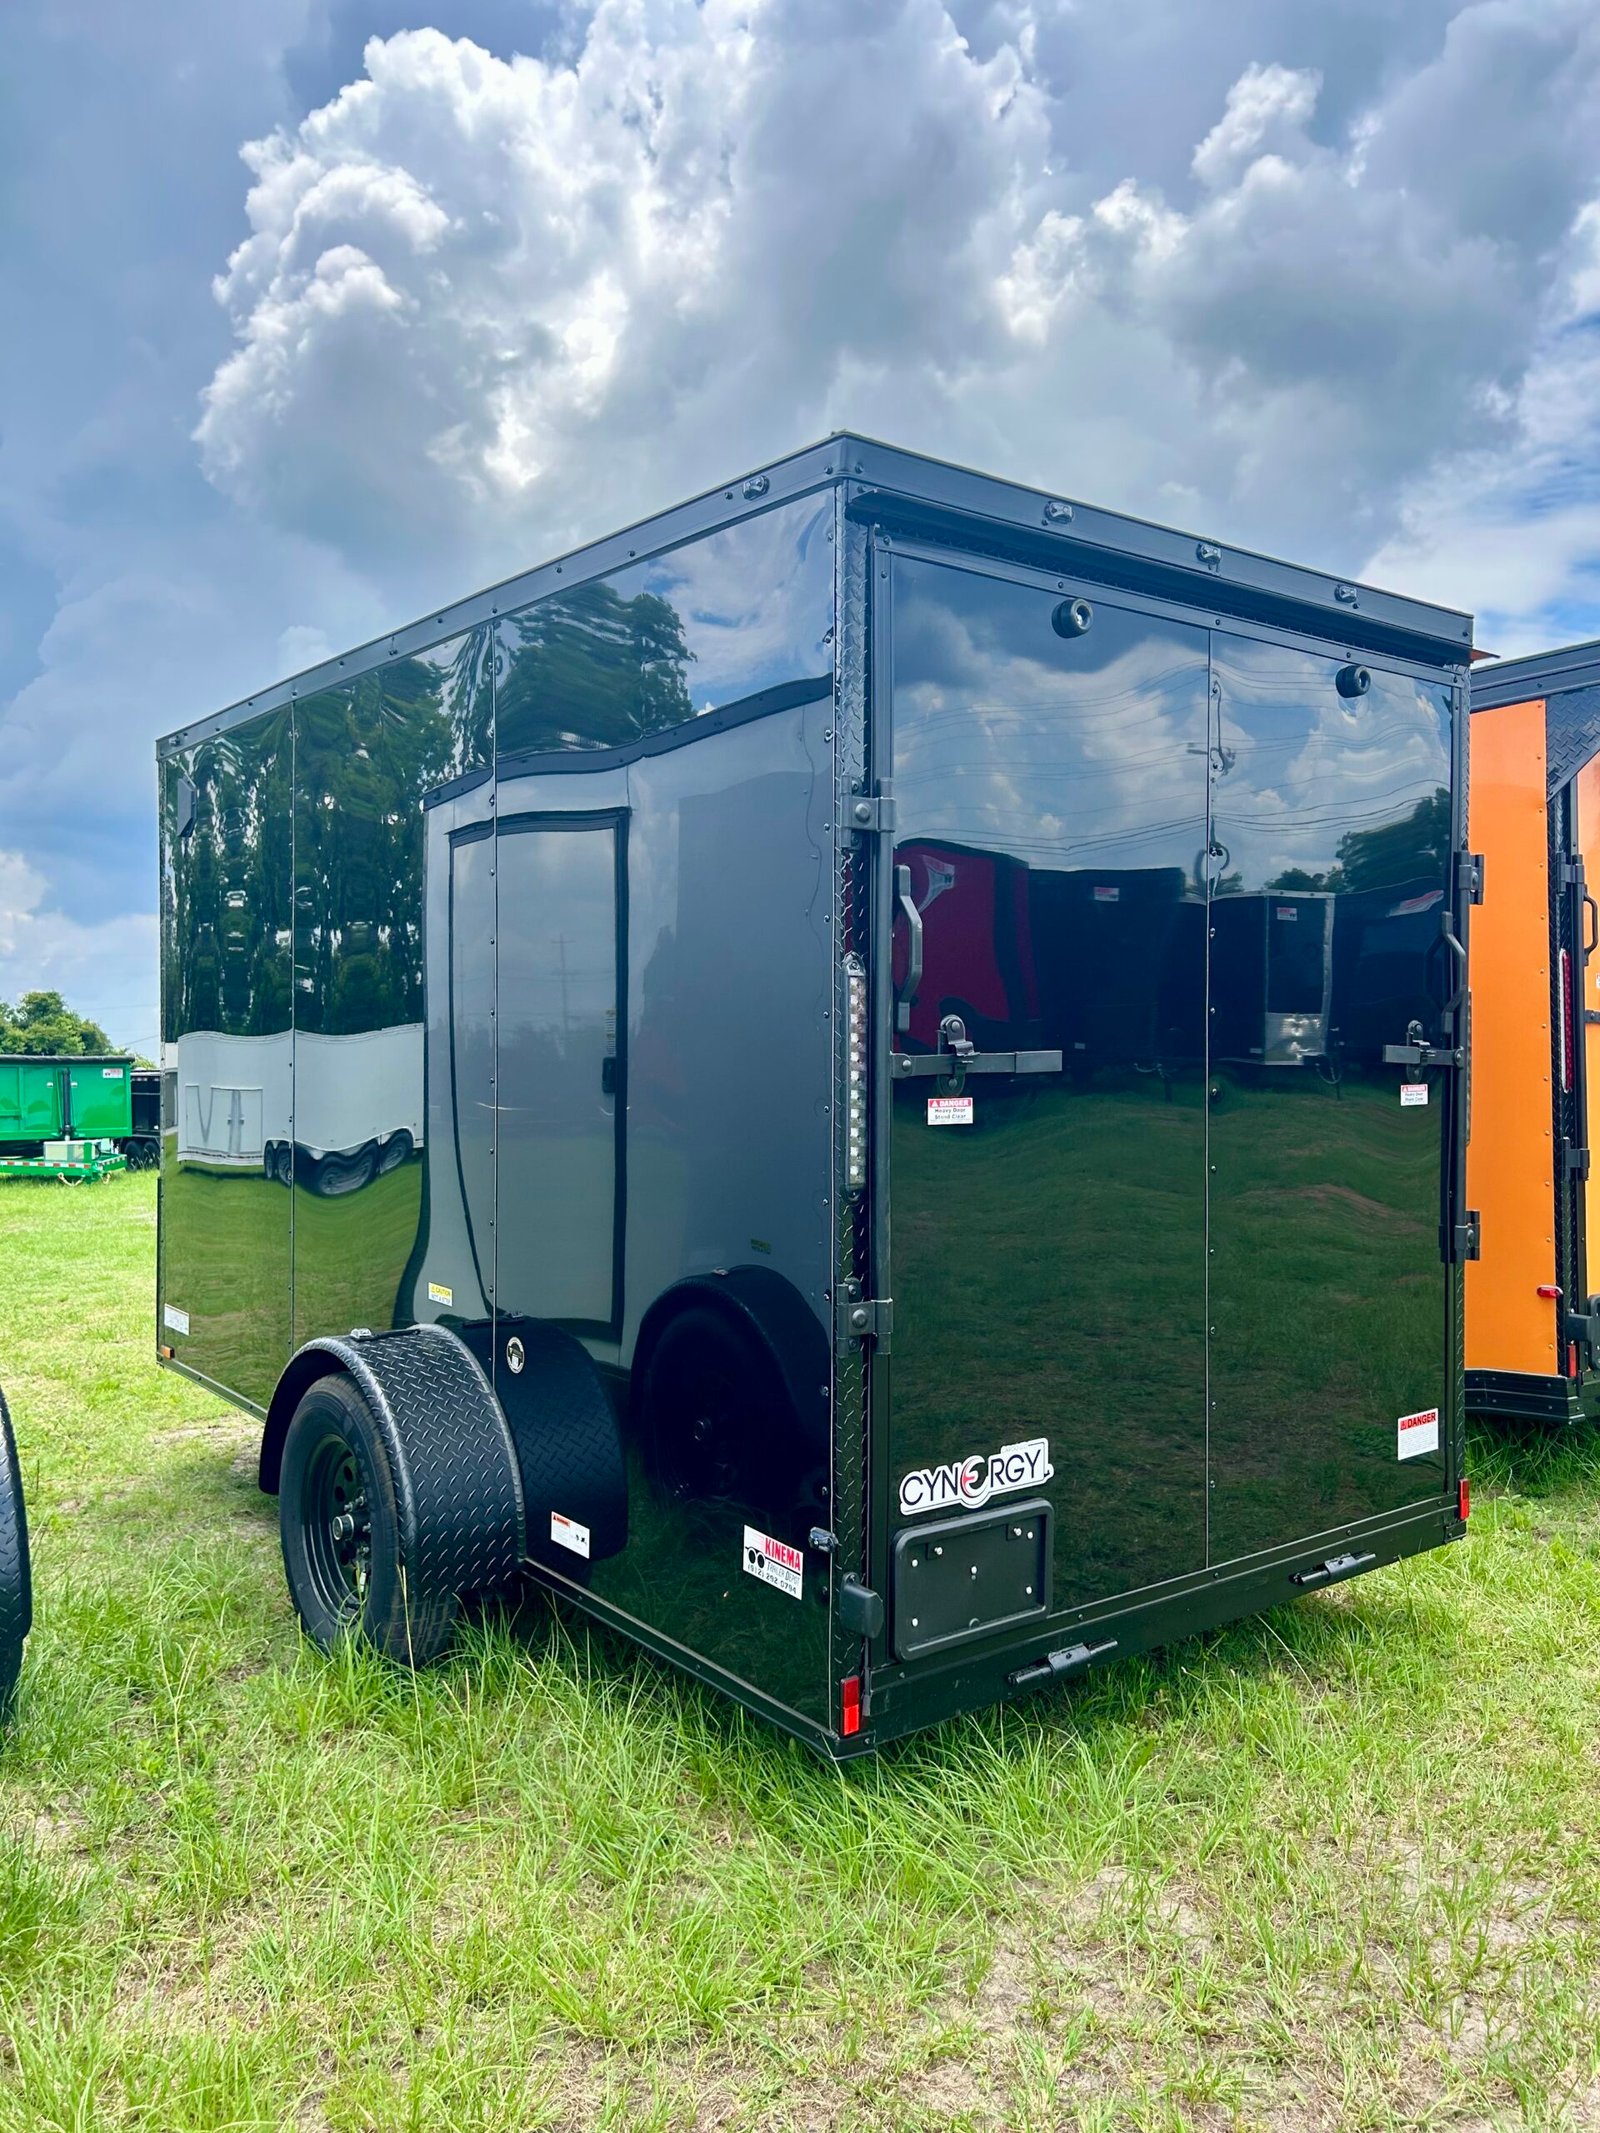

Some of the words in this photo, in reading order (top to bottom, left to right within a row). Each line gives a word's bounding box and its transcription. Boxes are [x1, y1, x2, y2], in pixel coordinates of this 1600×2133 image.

[939, 1099, 969, 1107] DANGER
[1407, 1412, 1436, 1428] DANGER
[902, 1449, 1042, 1506] CYNERGY
[765, 1537, 801, 1571] KINEMA
